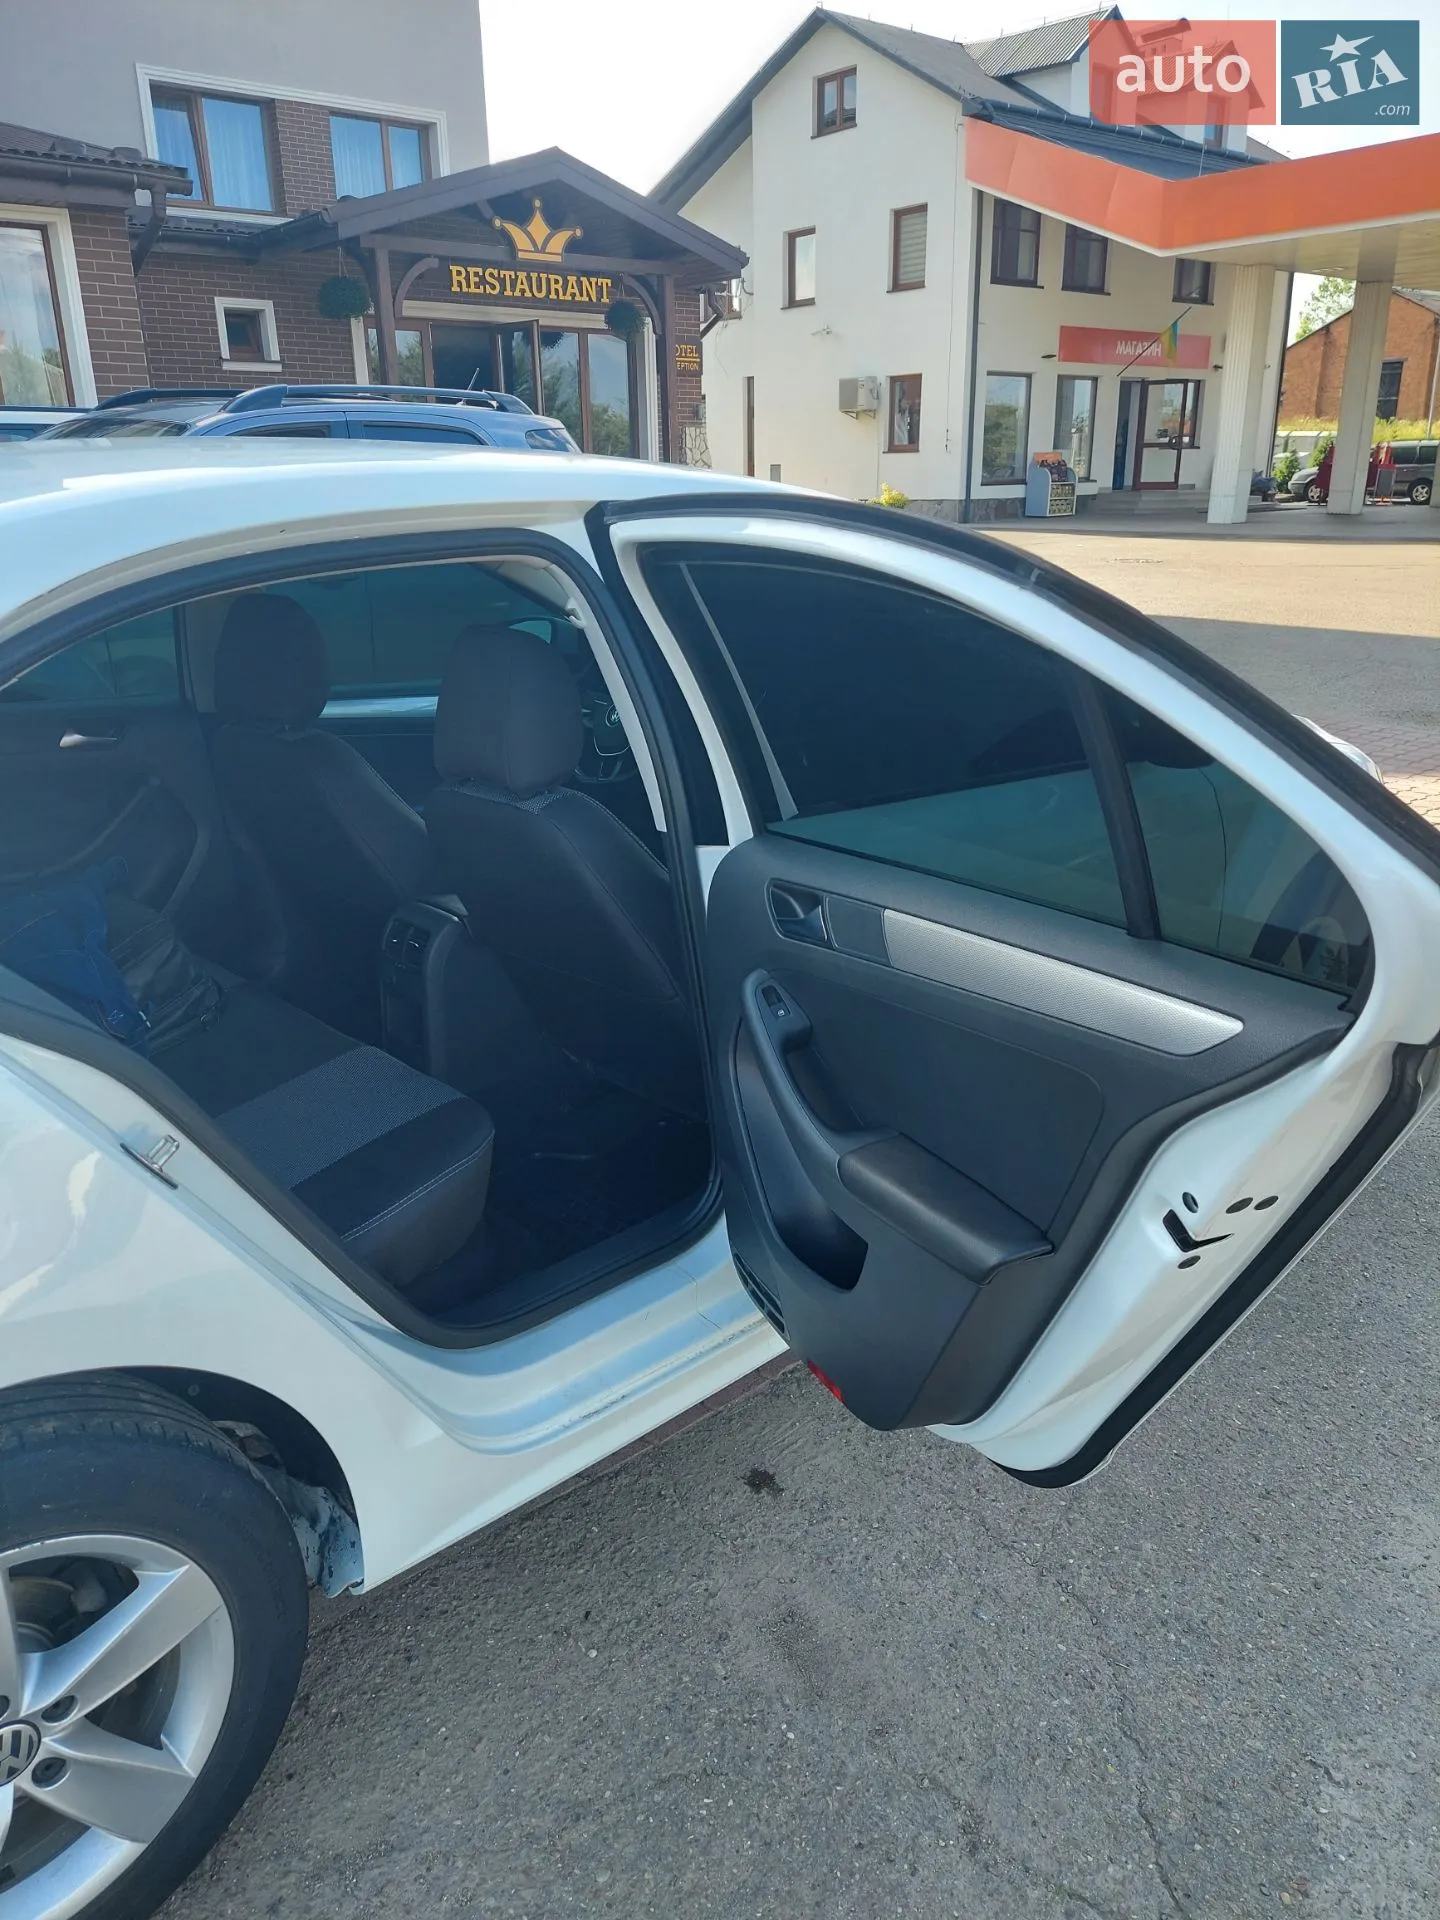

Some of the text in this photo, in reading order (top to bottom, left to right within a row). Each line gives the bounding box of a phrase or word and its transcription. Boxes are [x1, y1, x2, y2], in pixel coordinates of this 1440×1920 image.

[450, 265, 612, 303] RESTAURANT
[1115, 340, 1162, 357] МАГАЗИН
[676, 362, 699, 371] EPTION
